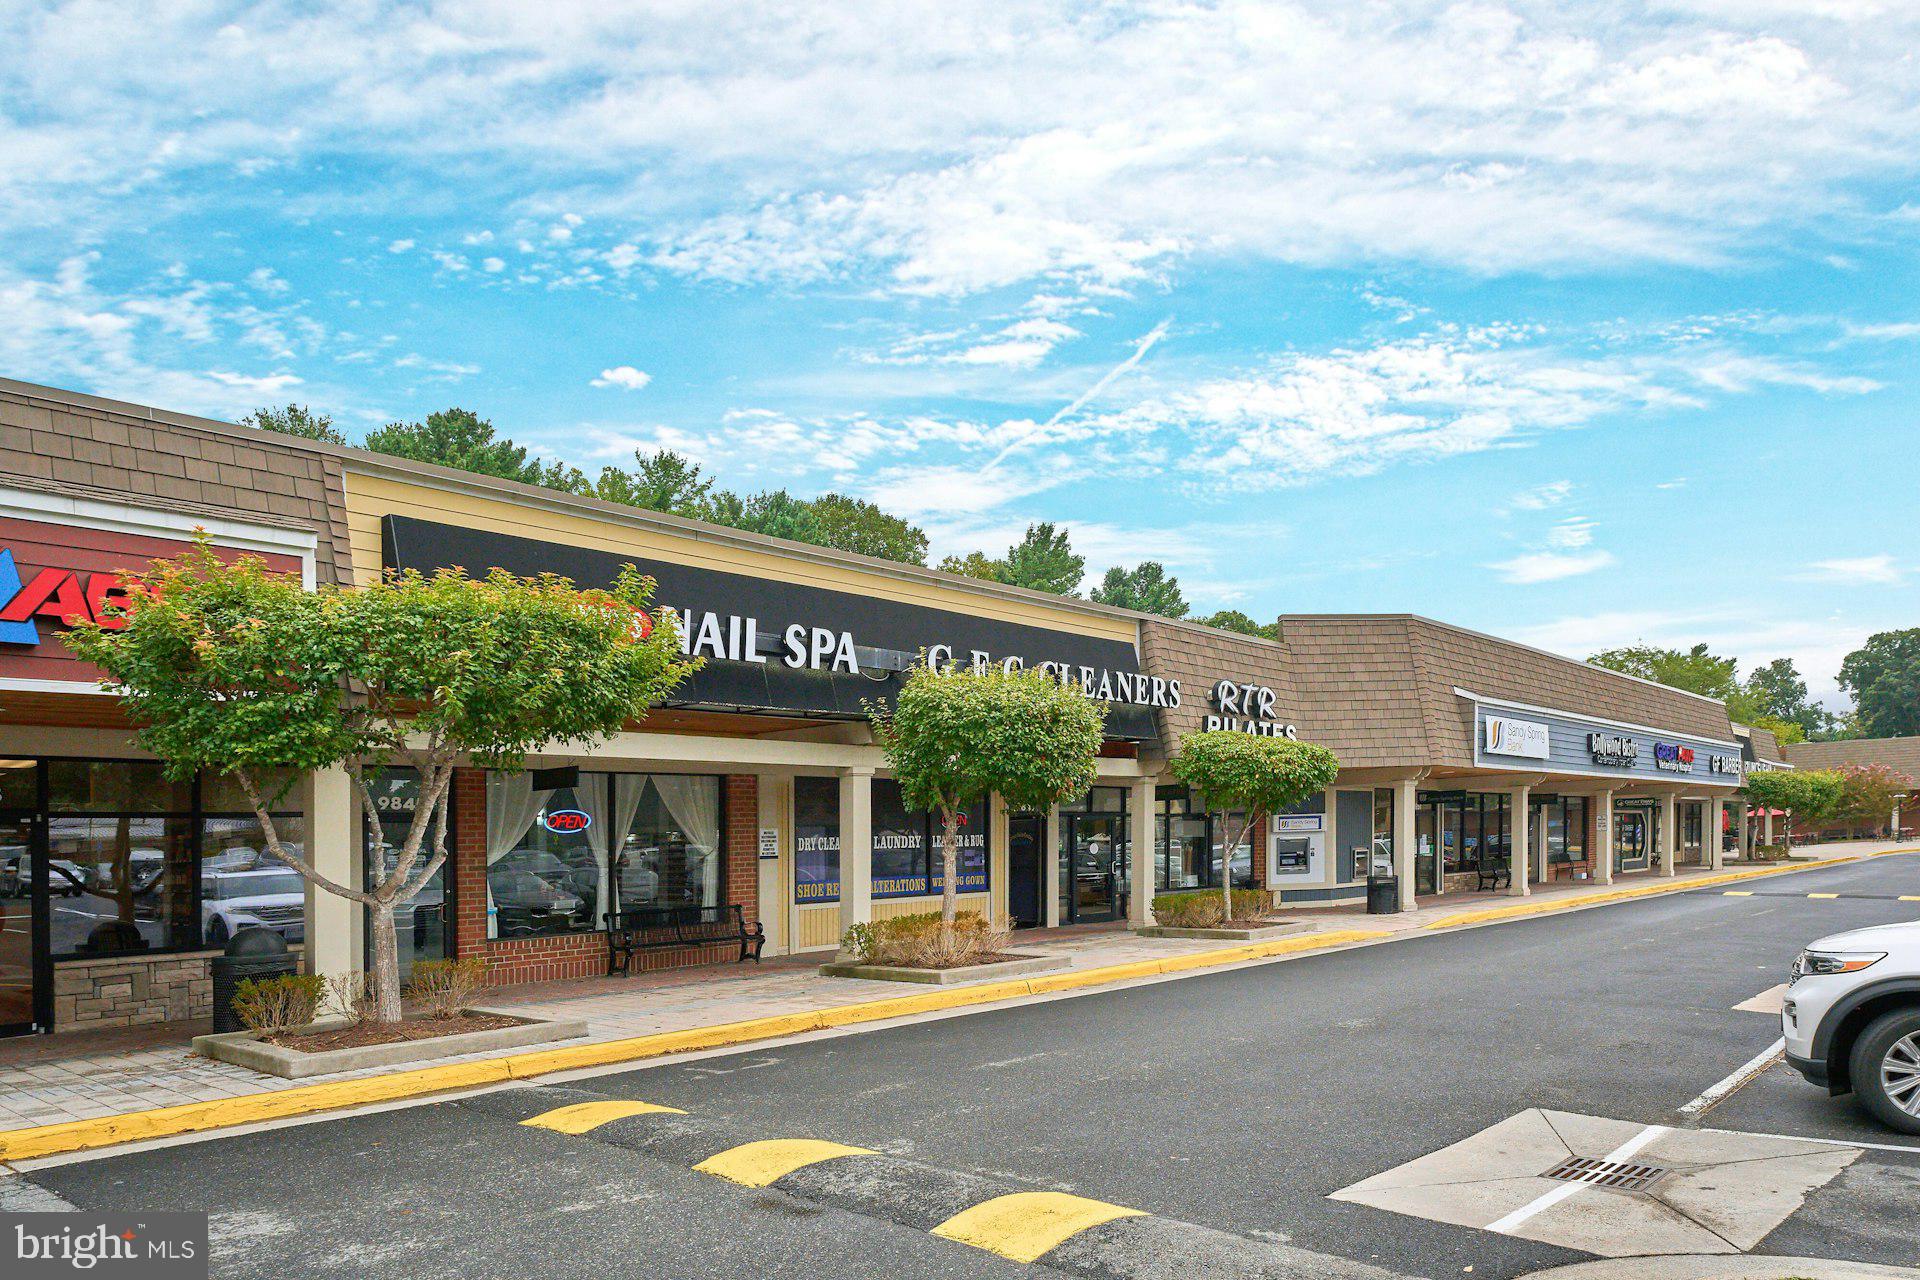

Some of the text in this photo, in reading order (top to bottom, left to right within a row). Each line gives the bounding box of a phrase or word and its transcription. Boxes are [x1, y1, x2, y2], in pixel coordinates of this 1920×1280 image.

[660, 605, 766, 664] NAIL
[784, 623, 859, 674] SPA
[1039, 661, 1181, 709] CLEANERS
[1218, 680, 1277, 718] RTR
[1508, 723, 1545, 744] Sandy Spring
[1592, 733, 1622, 756] Bollywood
[1656, 742, 1678, 761] GREAT
[378, 796, 419, 811] 984
[548, 815, 587, 829] OPEN
[798, 837, 816, 851] DRY
[874, 835, 921, 849] LAUNDRY
[971, 834, 984, 846] RUG
[966, 875, 985, 885] GOWN
[797, 884, 824, 898] SHOE
